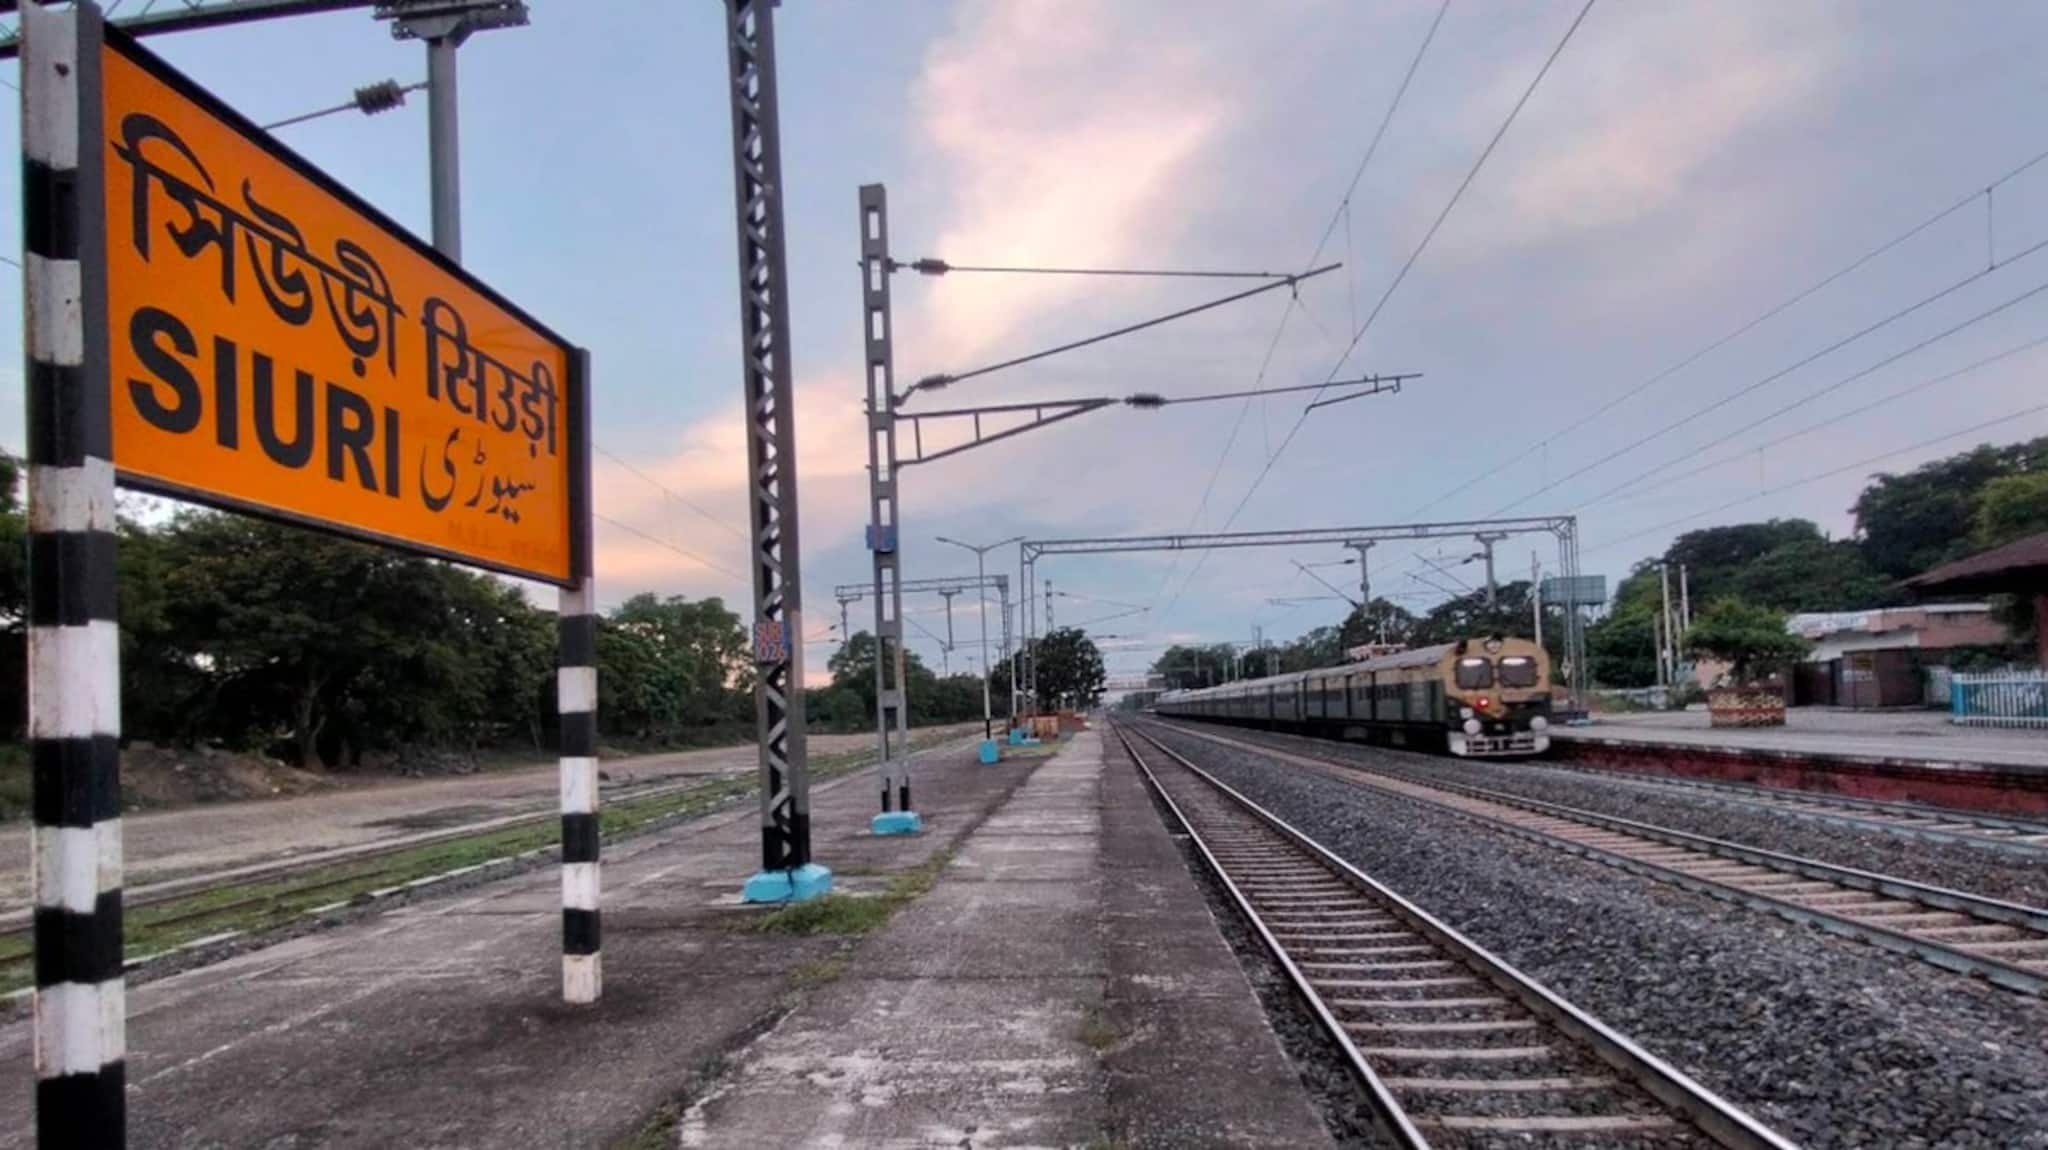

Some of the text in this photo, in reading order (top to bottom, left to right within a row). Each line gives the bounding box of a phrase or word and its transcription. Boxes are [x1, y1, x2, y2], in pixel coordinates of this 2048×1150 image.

[111, 112, 406, 378] সিউড়ী
[127, 306, 399, 499] SIURI
[420, 296, 559, 458] सिउड़ी
